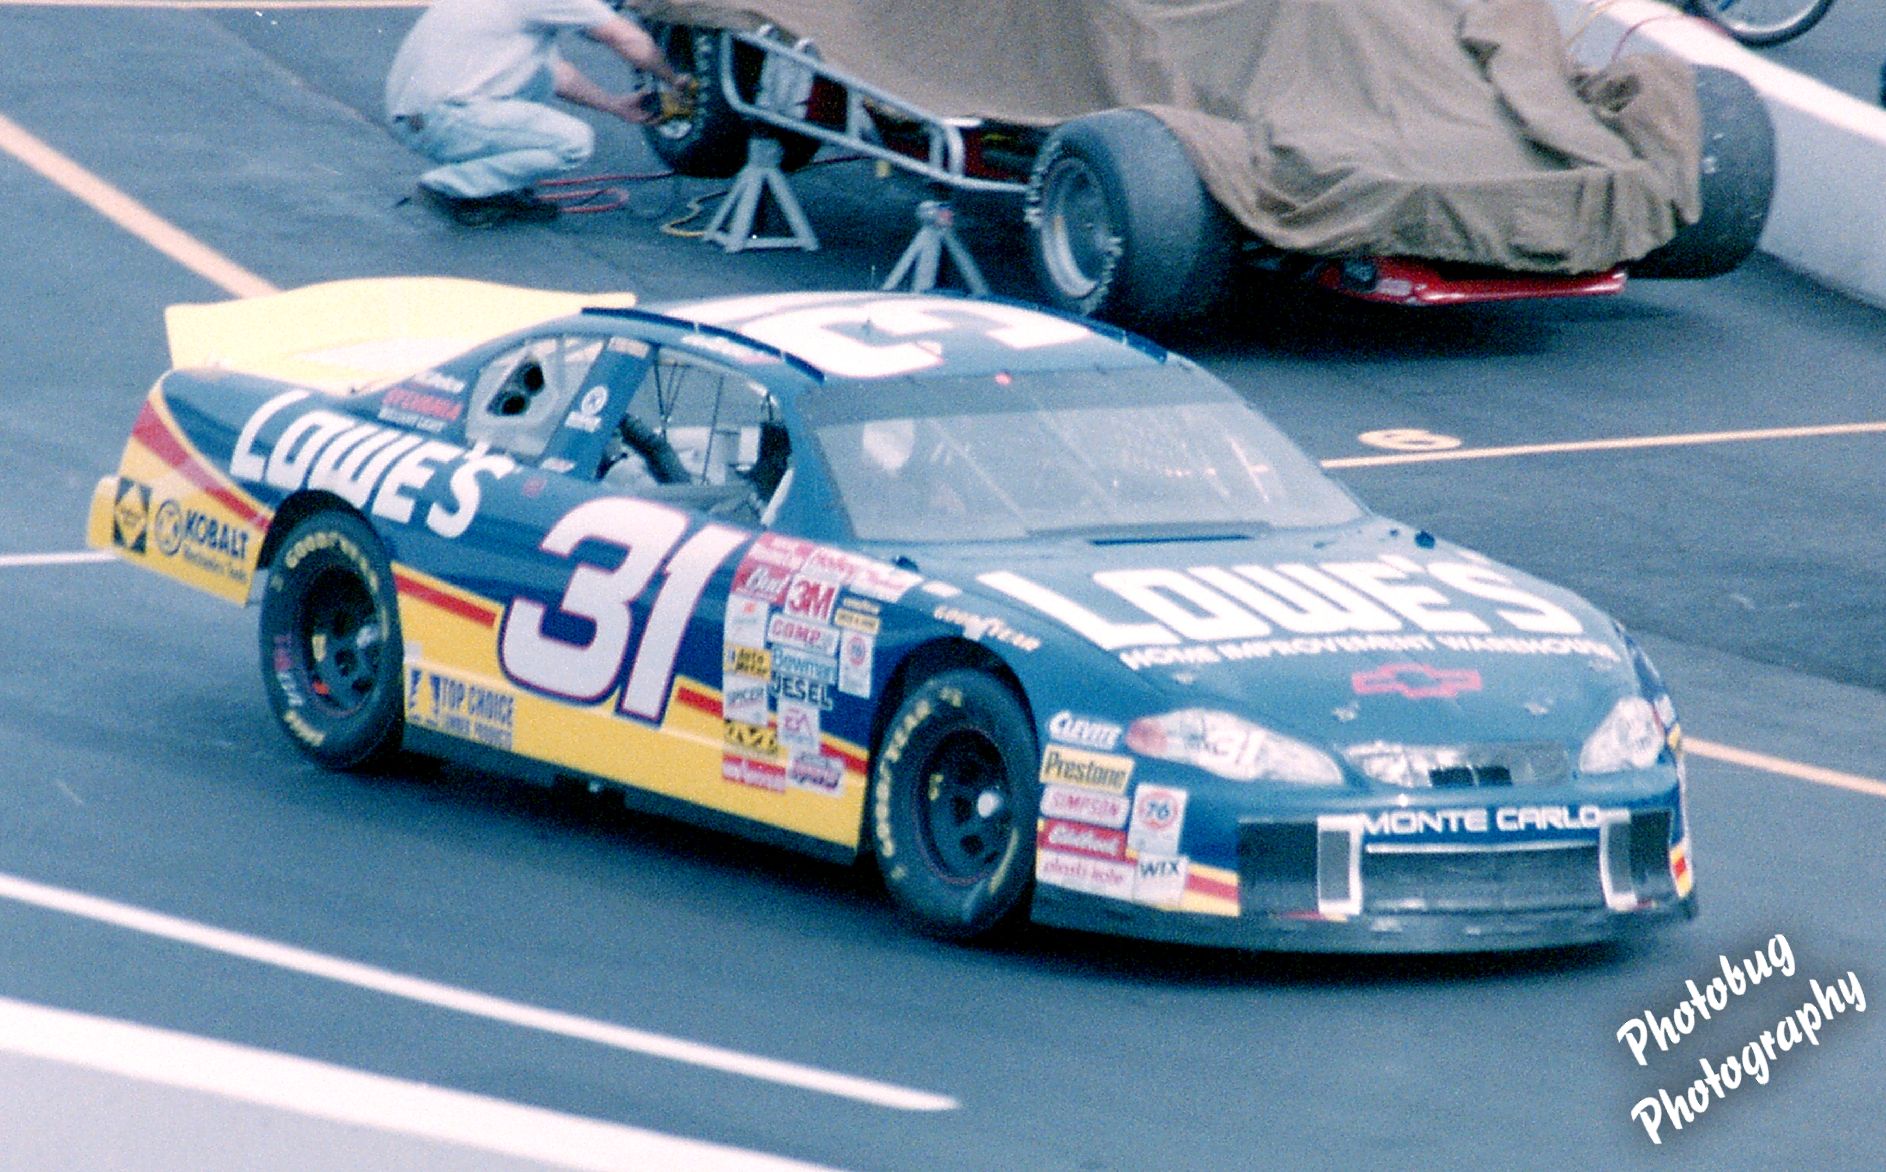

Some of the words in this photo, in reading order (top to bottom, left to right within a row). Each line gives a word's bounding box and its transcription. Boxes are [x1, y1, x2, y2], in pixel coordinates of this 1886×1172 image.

[230, 389, 516, 538] LOWE'S
[184, 508, 250, 561] KOBALT
[497, 497, 750, 728] 31
[788, 577, 836, 621] 3M
[975, 555, 1585, 652] LOWE'S
[769, 672, 833, 711] JESEL
[1045, 750, 1127, 790] Prestone
[1147, 802, 1171, 820] 76
[1362, 801, 1488, 835] MONTE
[1496, 805, 1602, 832] CARLO
[1138, 860, 1181, 878] WIX
